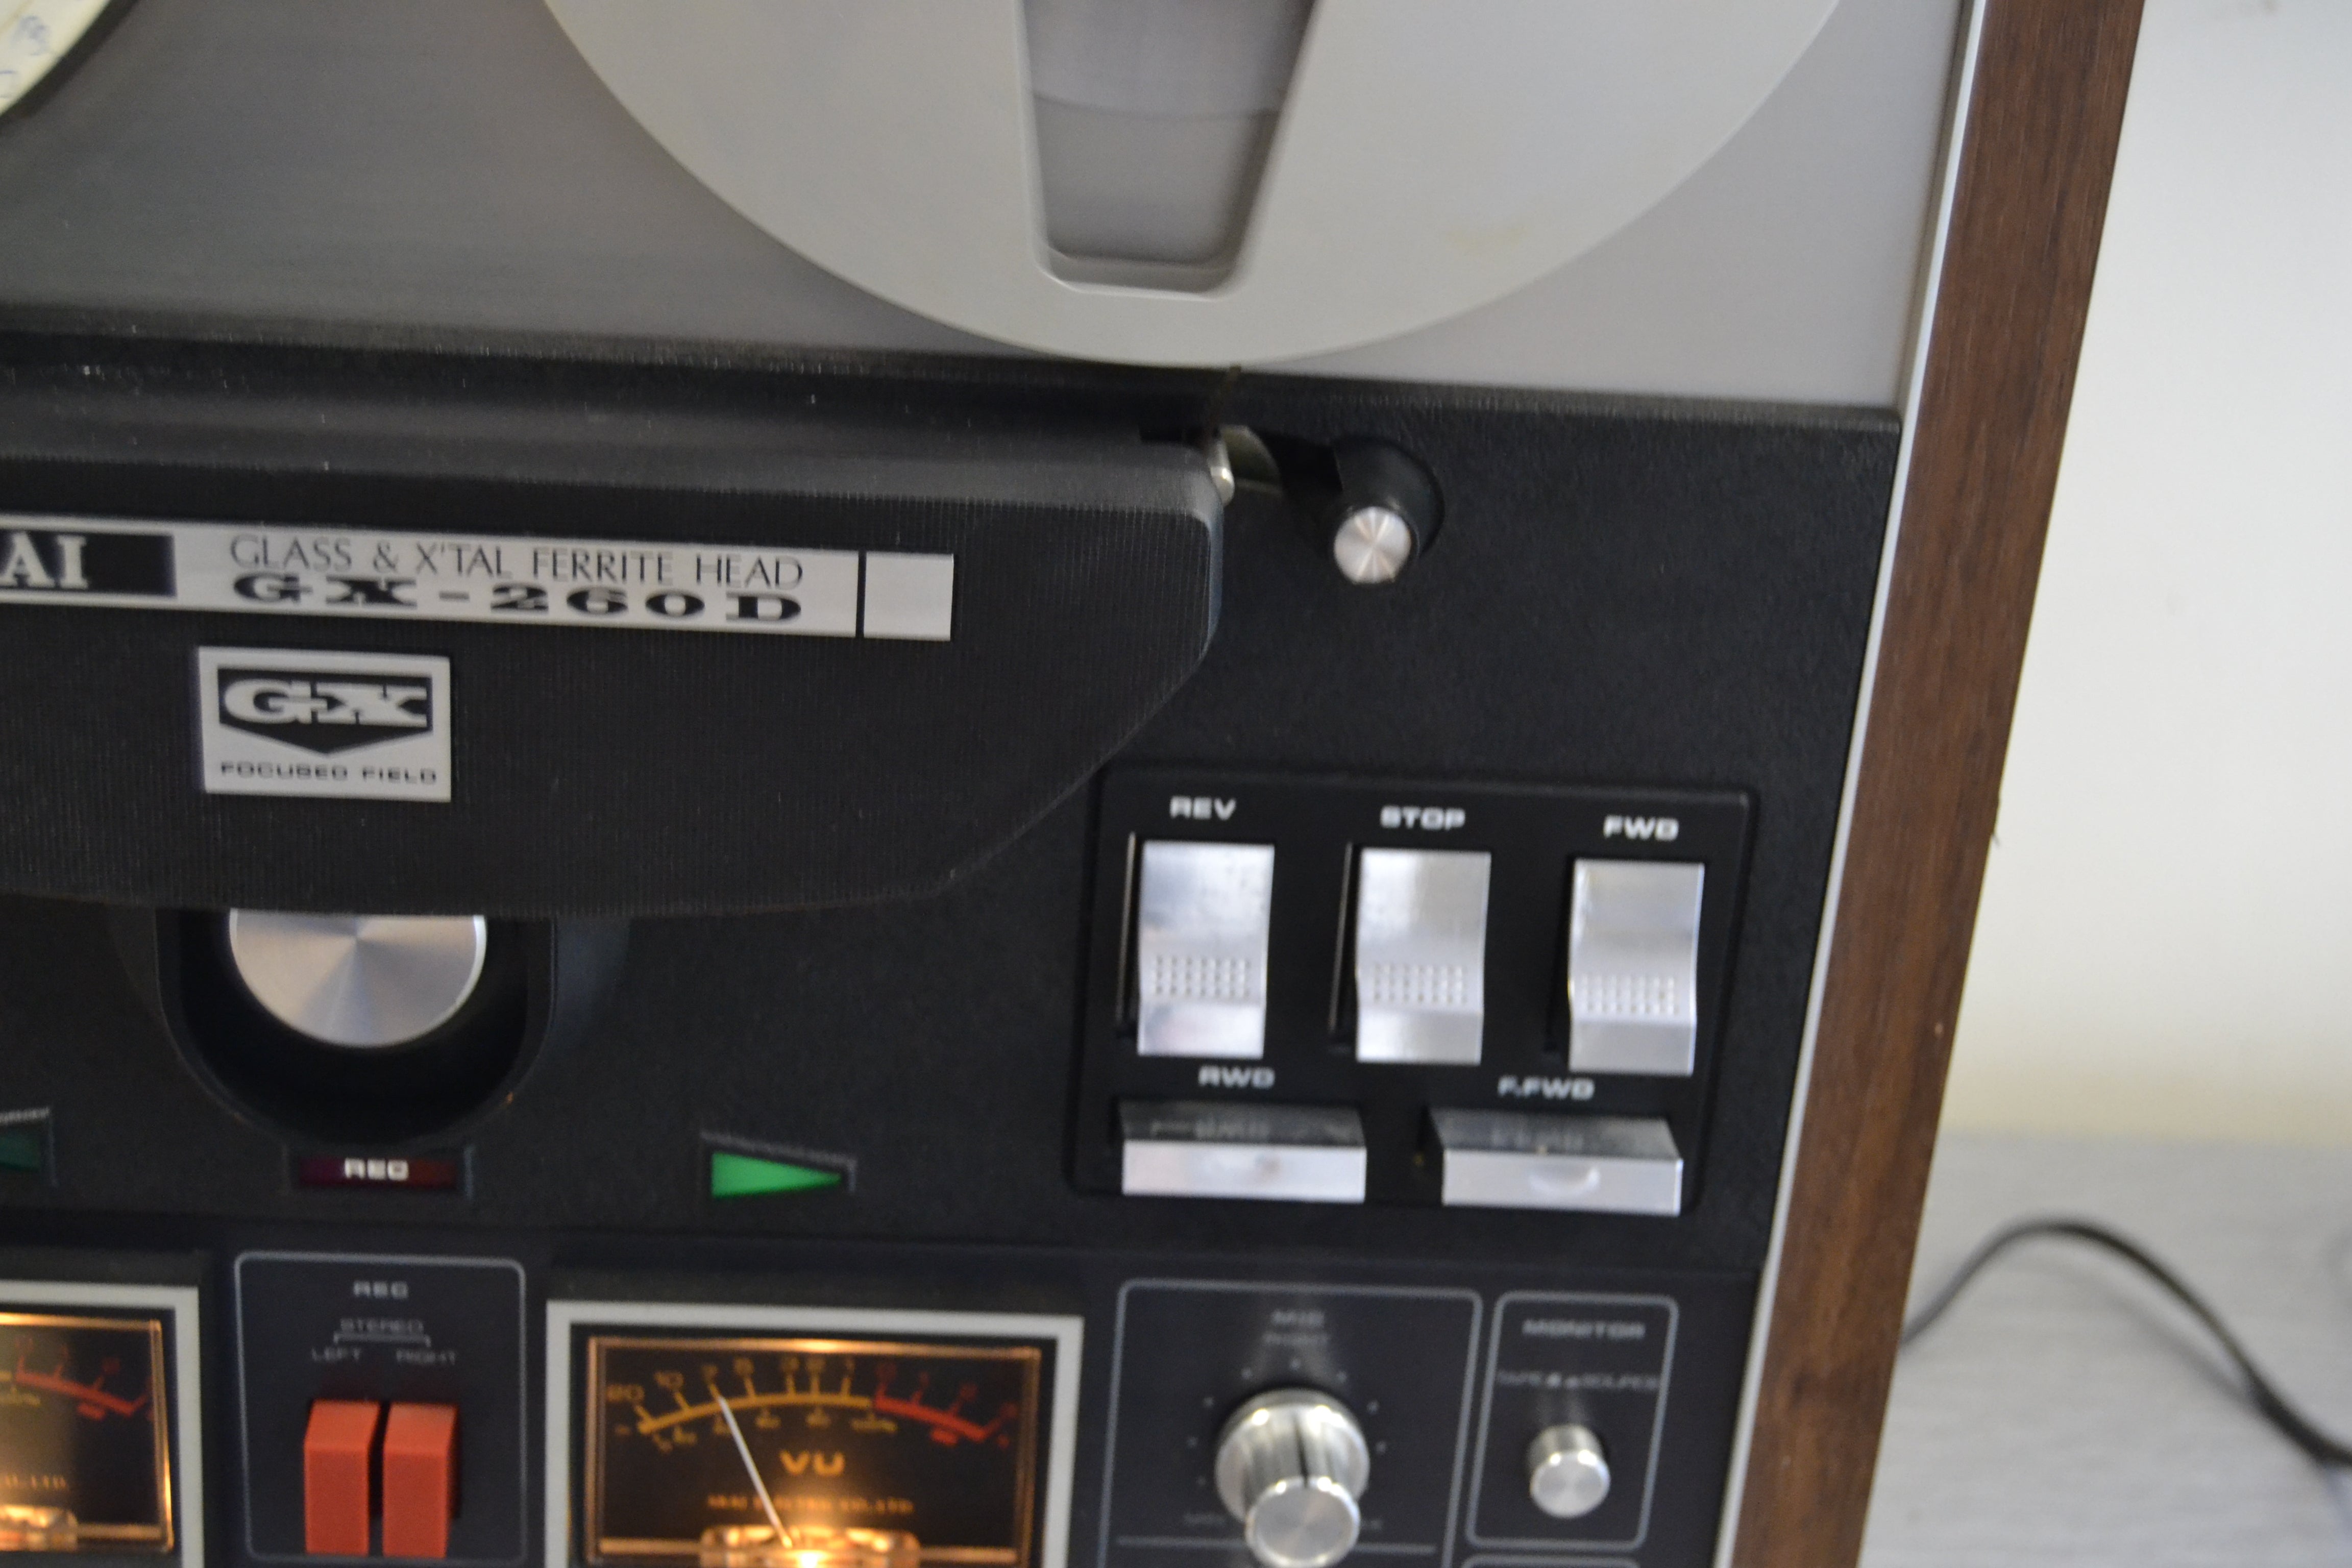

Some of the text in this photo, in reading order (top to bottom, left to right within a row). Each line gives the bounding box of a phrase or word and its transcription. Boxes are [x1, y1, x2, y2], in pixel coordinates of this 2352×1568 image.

[230, 534, 803, 590] GLASS & X'TAL FERRITE HEAD
[225, 678, 428, 728] GX
[220, 762, 437, 785] FOCUSED FIELD
[1169, 795, 1237, 820] REV
[1380, 805, 1466, 830] STOP
[1603, 815, 1679, 841] FWD
[1198, 1065, 1275, 1089] RWD
[779, 1450, 846, 1477] VU
